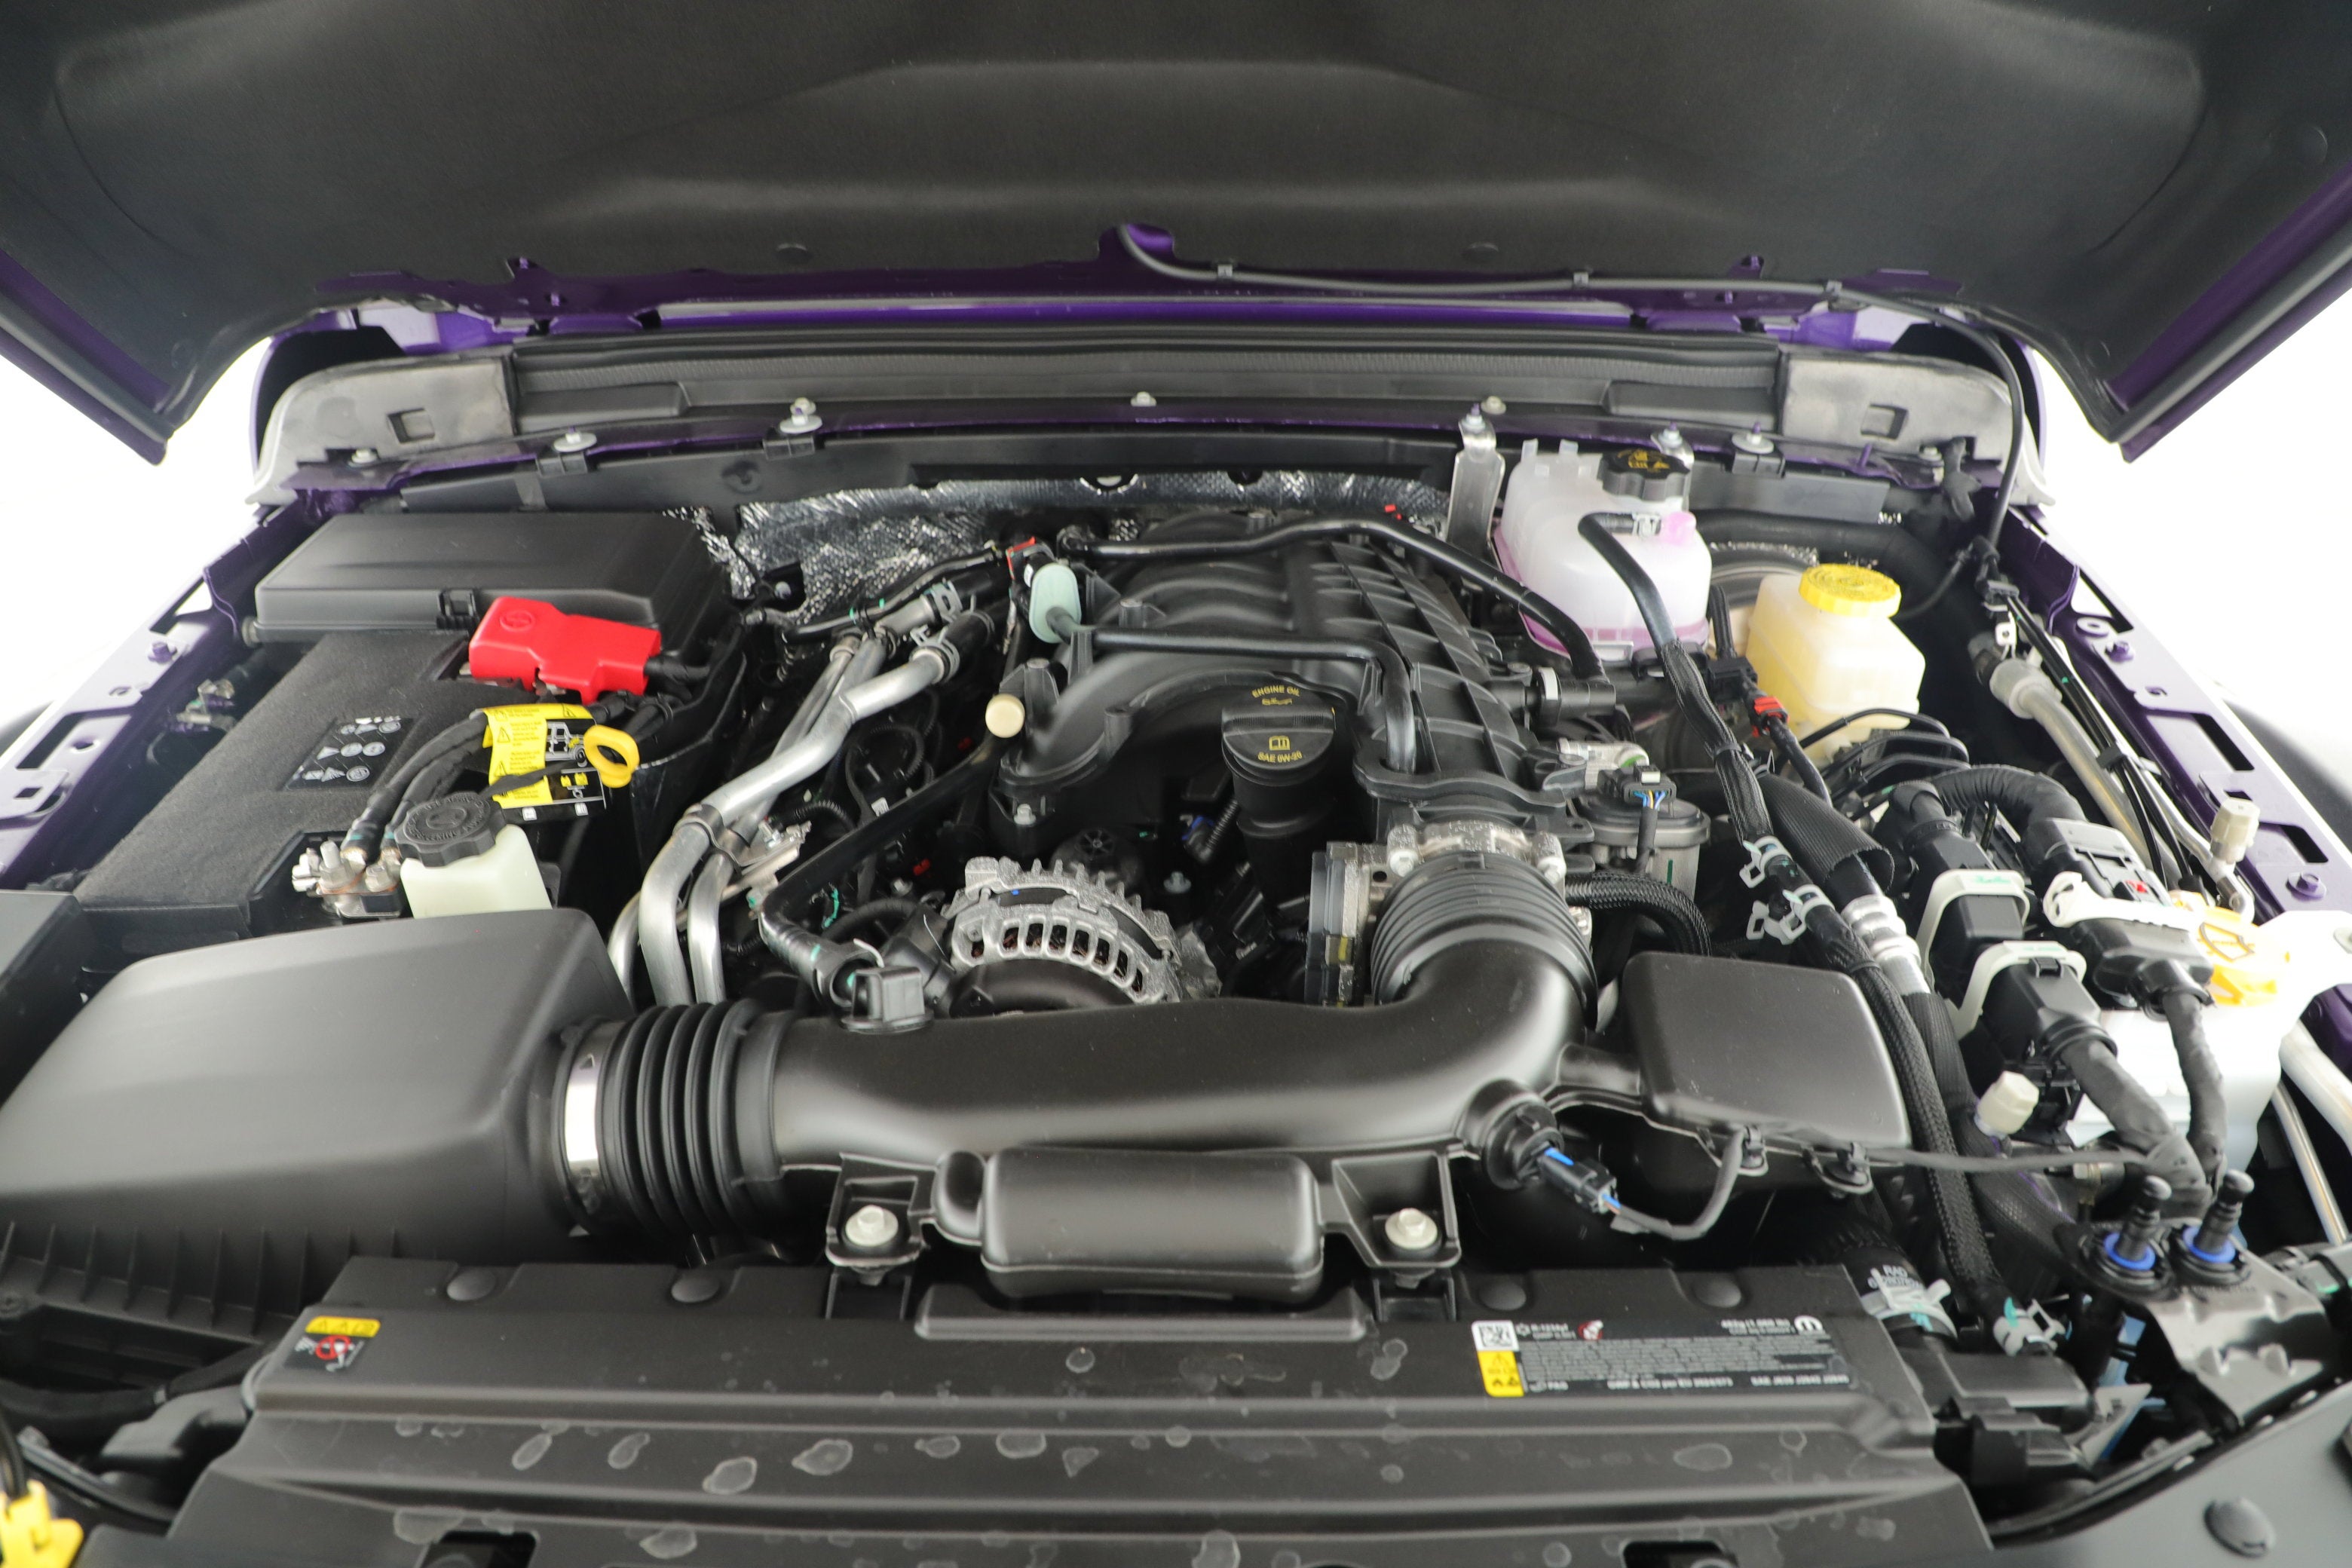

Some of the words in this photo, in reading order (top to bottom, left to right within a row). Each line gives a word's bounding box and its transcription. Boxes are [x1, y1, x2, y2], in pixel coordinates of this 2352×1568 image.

[1252, 685, 1285, 697] ENGINE
[1287, 686, 1300, 697] OIL
[1257, 752, 1276, 763] SAE
